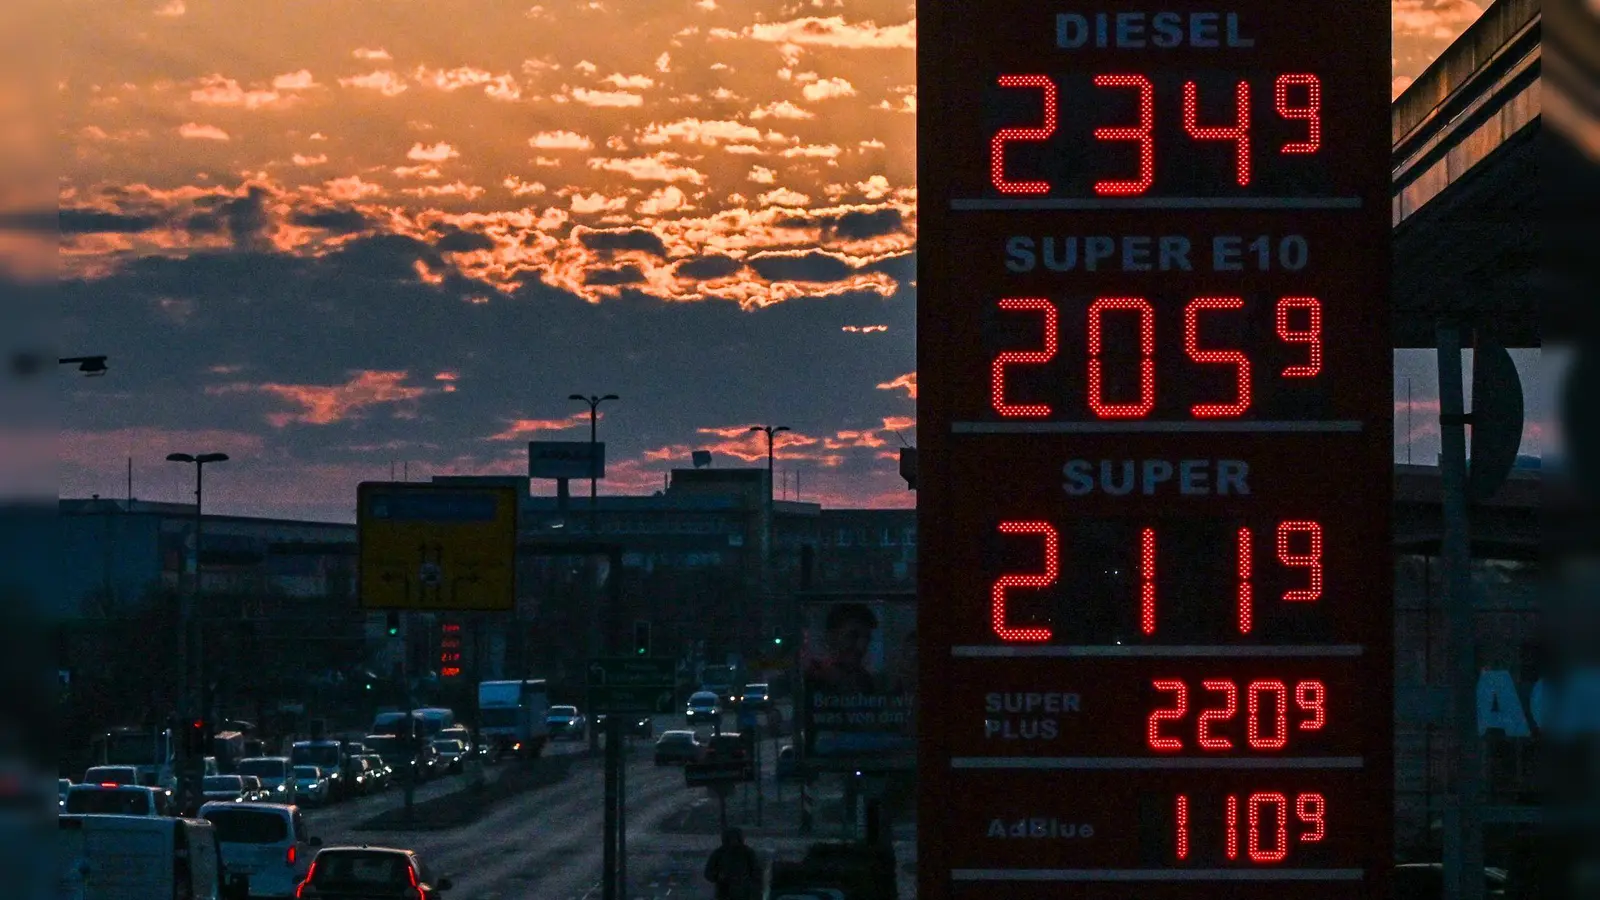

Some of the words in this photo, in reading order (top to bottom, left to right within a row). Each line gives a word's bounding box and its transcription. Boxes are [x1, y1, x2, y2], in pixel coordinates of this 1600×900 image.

[1055, 11, 1254, 49] DIESEL
[1004, 235, 1193, 272] SUPER
[1212, 234, 1310, 272] E10
[1062, 459, 1251, 496] SUPER
[813, 691, 887, 707] Brauchen
[985, 692, 1081, 713] SUPER
[813, 712, 843, 724] was
[984, 718, 1059, 740] PLUS
[987, 817, 1095, 839] AdBlue
